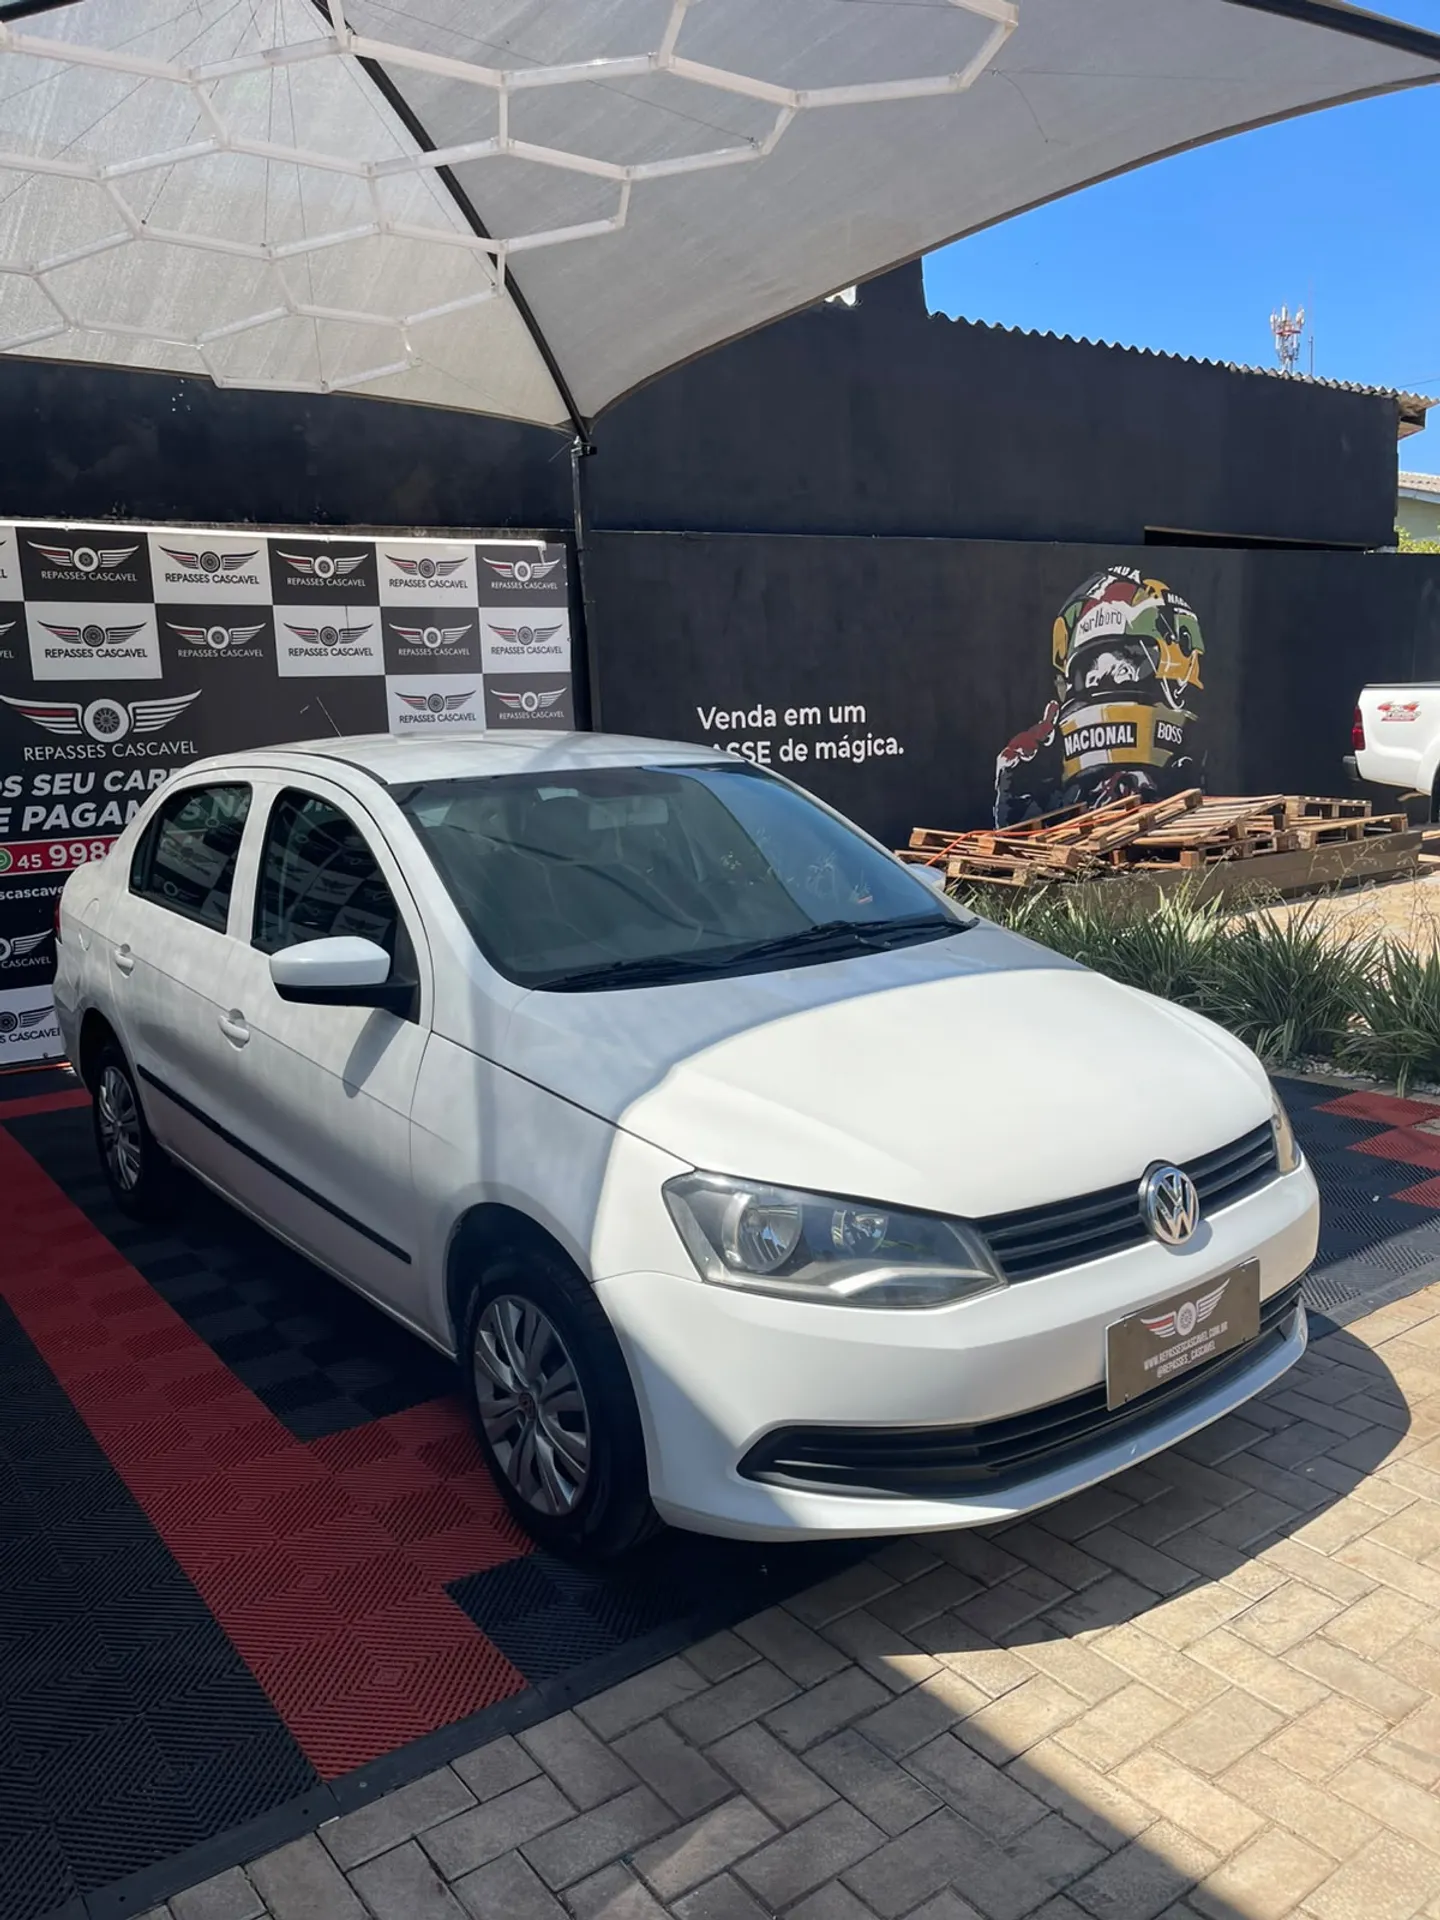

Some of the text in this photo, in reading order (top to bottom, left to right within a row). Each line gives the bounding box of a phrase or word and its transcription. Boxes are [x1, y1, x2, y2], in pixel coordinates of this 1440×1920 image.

[41, 570, 138, 582] REPASSES CASCAVEL
[164, 572, 260, 585] REPASSES CASCAVEL
[286, 577, 366, 588] REPASSES CASCAVEL
[388, 579, 469, 589] REPASSES CASCAVEL
[490, 581, 558, 590] REPASSES CASCAVEL
[44, 648, 148, 658] REPASSES CASCAVEL
[177, 649, 264, 658] REPASSES CASCAVEL
[287, 648, 374, 657] REPASSES CASCAVEL
[397, 647, 470, 656] REPASSES CASCAVEL
[490, 645, 563, 655] REPASSES CASCAVEL
[399, 712, 477, 724] REPASSES CASCAVEL
[499, 710, 565, 720] REPASSES CASCAVEL
[696, 704, 866, 730] Venda em um
[1157, 722, 1183, 744] BOSS
[1064, 724, 1135, 756] NACIONAL
[24, 740, 199, 761] REPASSES CASCAVEL
[713, 733, 904, 763] SSE de mágica.
[31, 772, 95, 797] SEU
[17, 841, 118, 869] 45 998
[1, 955, 52, 968] CASCAVEL
